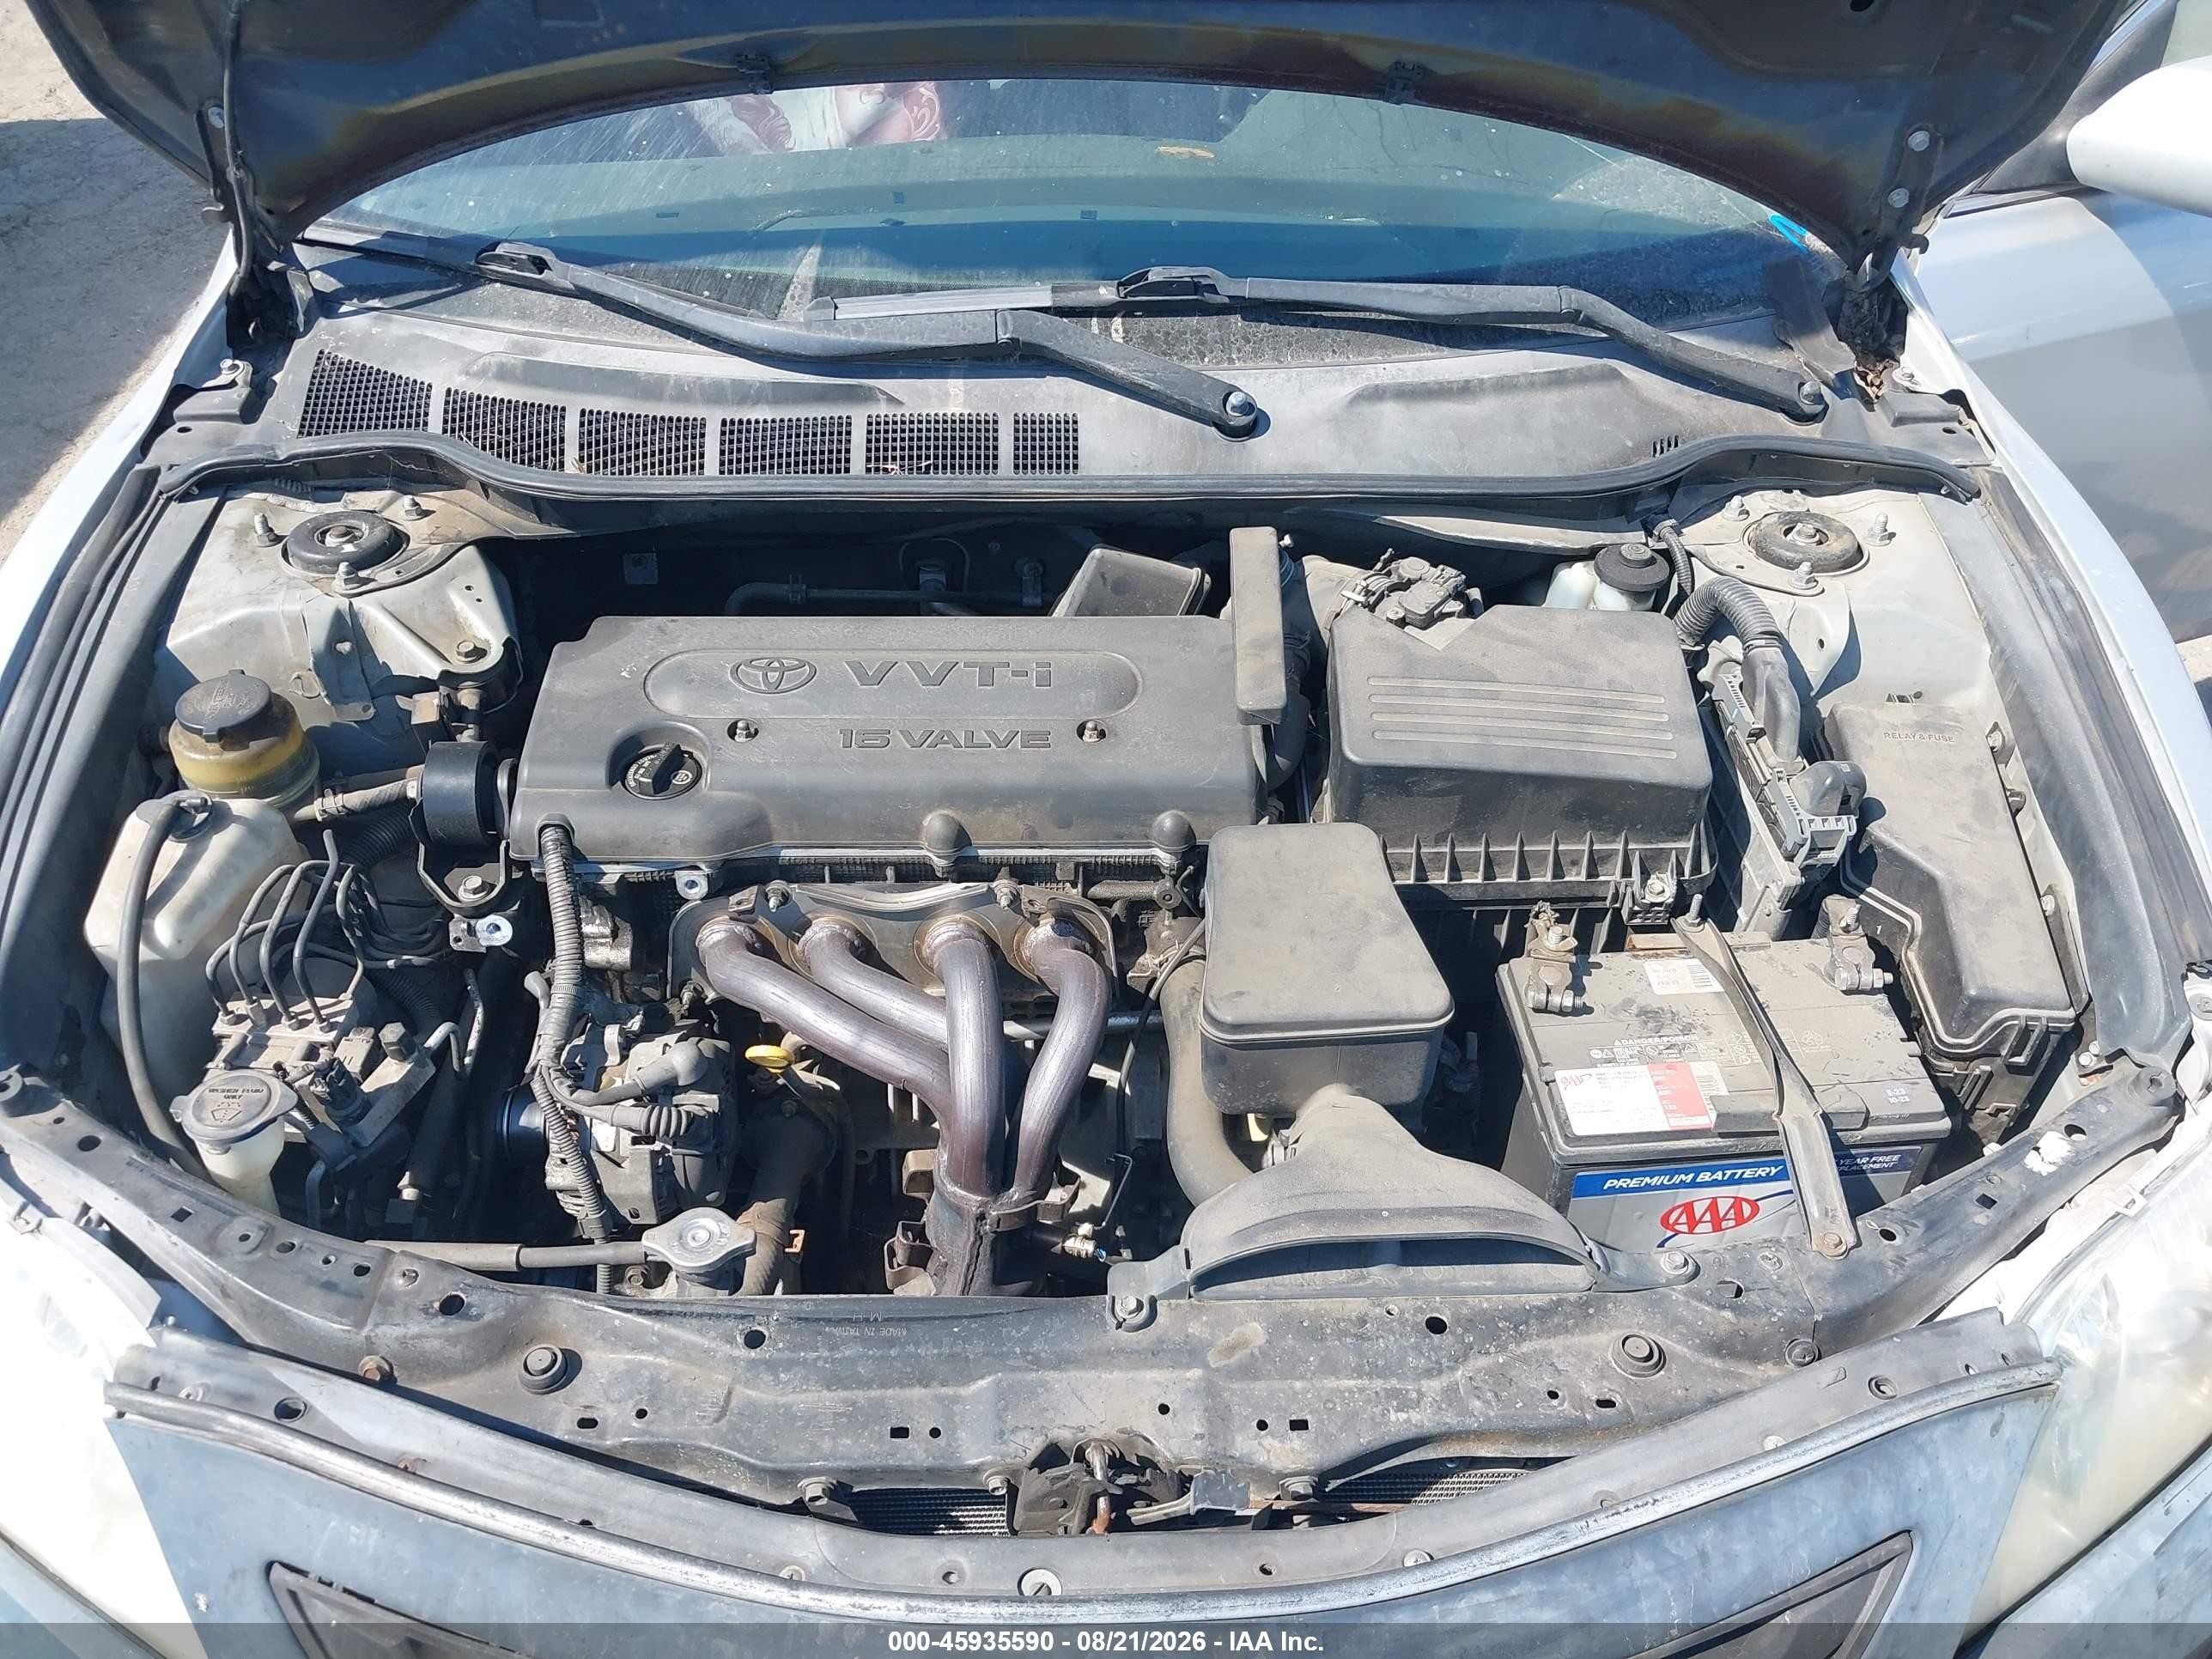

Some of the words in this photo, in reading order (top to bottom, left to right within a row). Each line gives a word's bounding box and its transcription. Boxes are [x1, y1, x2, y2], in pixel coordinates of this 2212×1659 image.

[844, 661, 1052, 688] VVT-i
[838, 729, 891, 749] 16
[897, 729, 1052, 749] VALVE
[1928, 734, 1955, 743] FUSE
[1838, 1162, 1898, 1171] PLACEMENT
[1839, 1157, 1869, 1166] YEAR
[1869, 1154, 1902, 1164] FREE
[1602, 1173, 1693, 1189] PREMIUM
[1695, 1165, 1784, 1183] BATTERY
[1668, 1196, 1755, 1234] AAA
